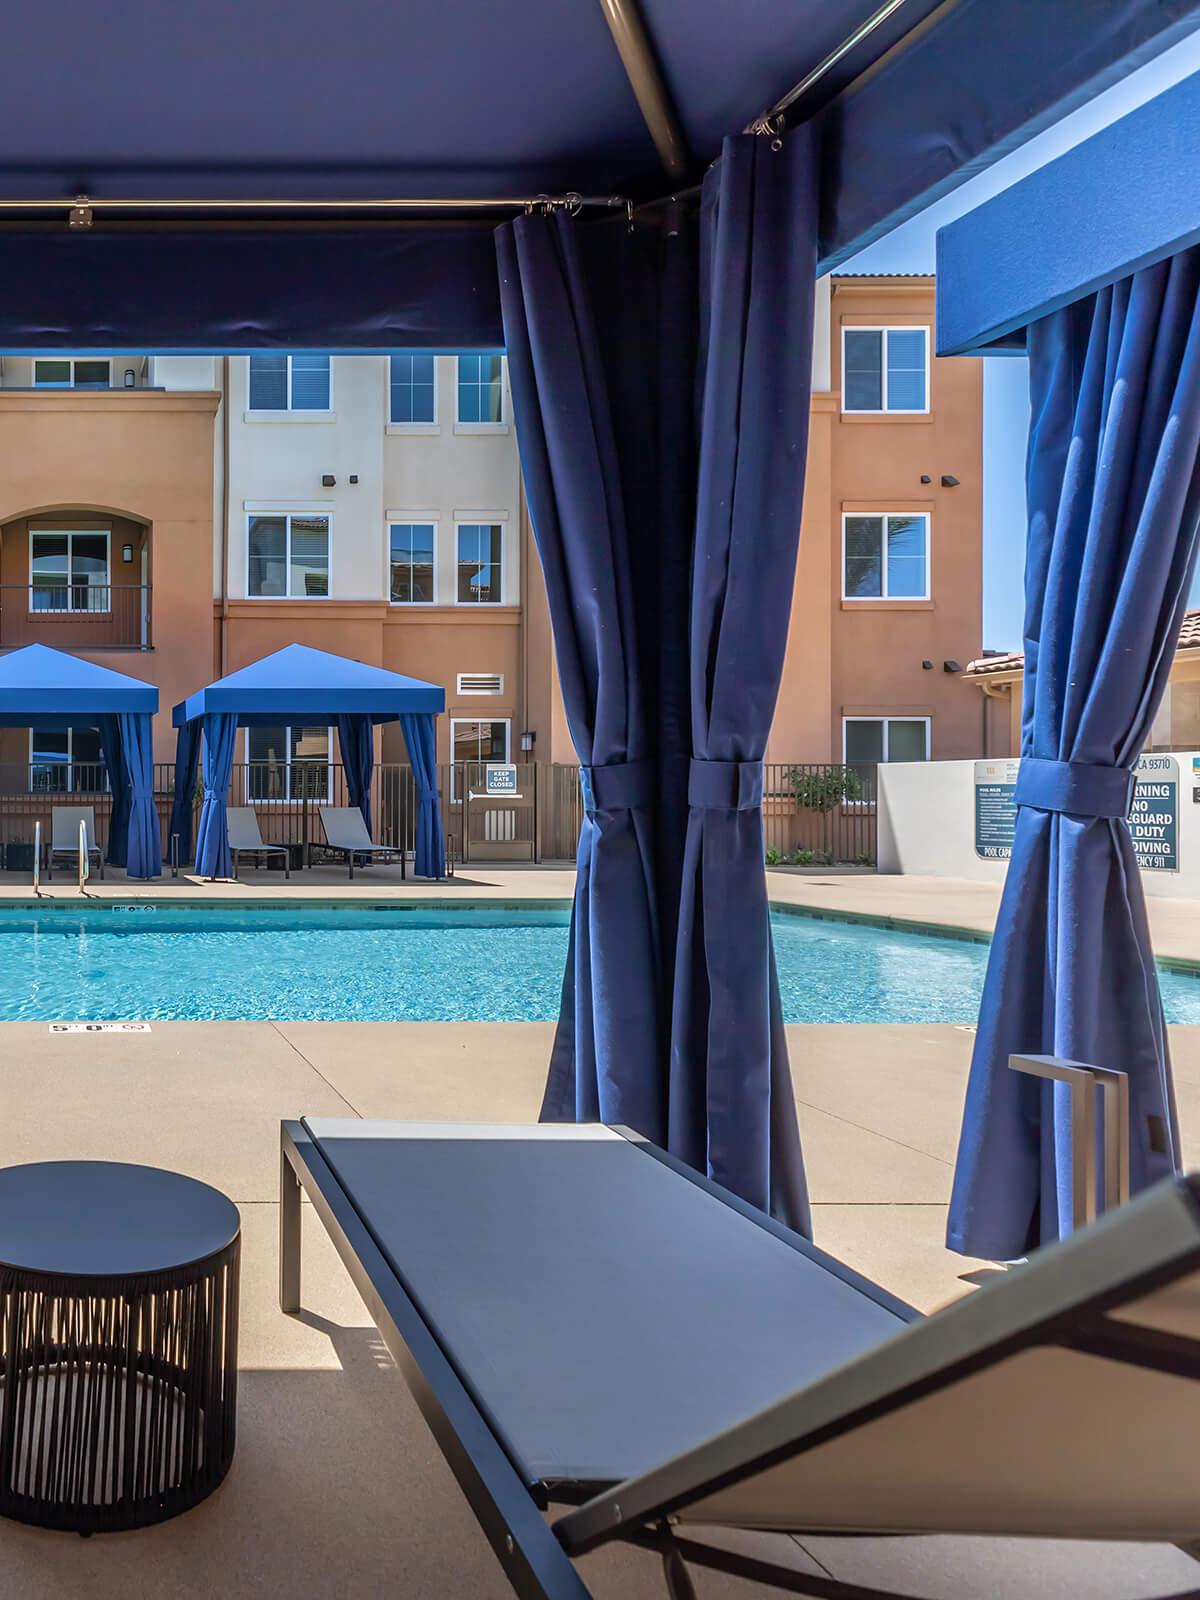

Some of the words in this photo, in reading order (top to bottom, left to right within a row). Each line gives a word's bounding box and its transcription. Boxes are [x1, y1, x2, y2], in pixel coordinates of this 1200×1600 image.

[1149, 759, 1171, 770] 93710
[1132, 801, 1148, 811] NO
[1136, 826, 1165, 837] DUTY
[984, 847, 998, 857] POOL
[1154, 857, 1165, 868] 911
